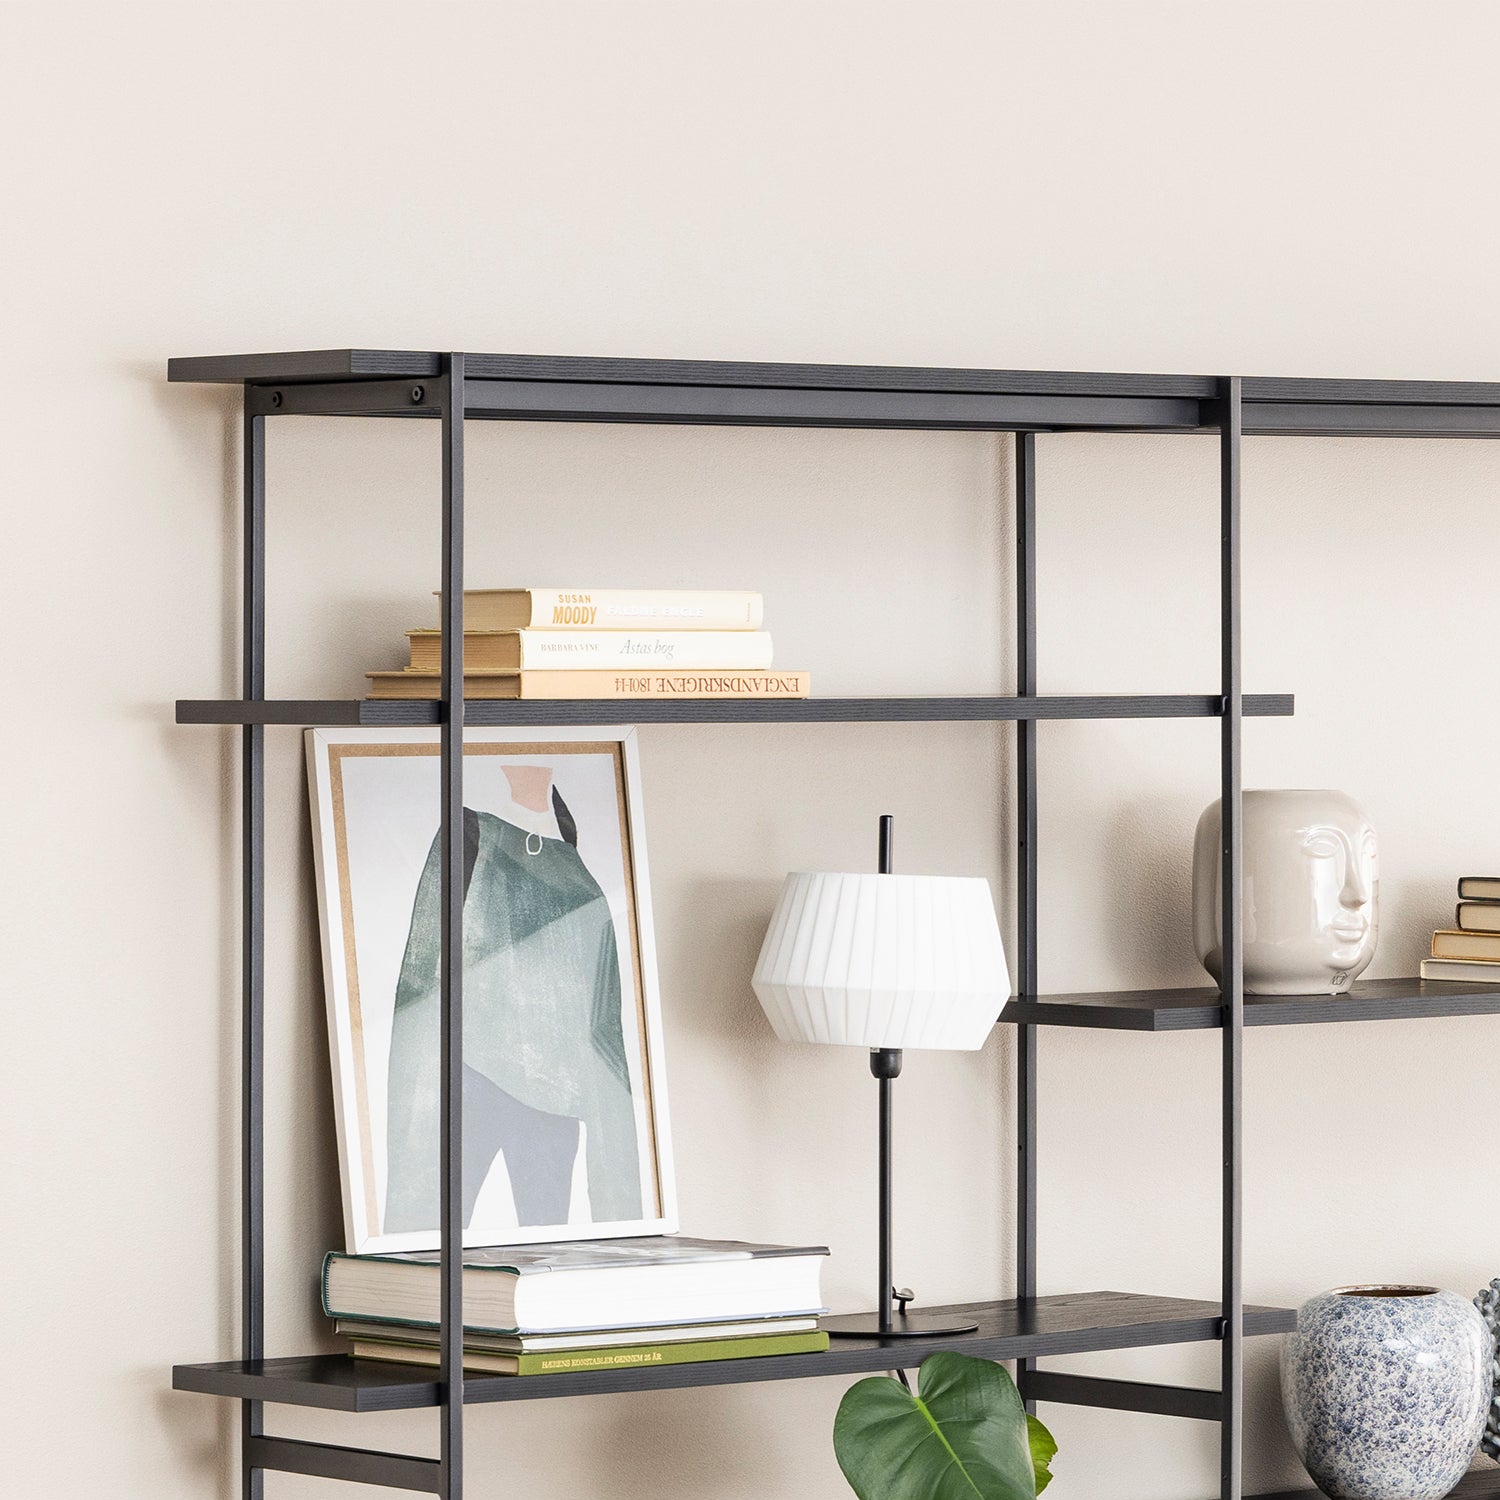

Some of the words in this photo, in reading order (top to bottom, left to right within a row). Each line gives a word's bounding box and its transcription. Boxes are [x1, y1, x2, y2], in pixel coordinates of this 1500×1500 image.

[558, 594, 592, 604] SUSAN
[552, 606, 598, 625] MOODY
[540, 643, 578, 653] BARBARA
[619, 639, 652, 654] Astas
[654, 639, 676, 660] bog
[656, 677, 800, 693] ENGLANDSKRIGENE
[614, 1354, 643, 1364] GENNEM
